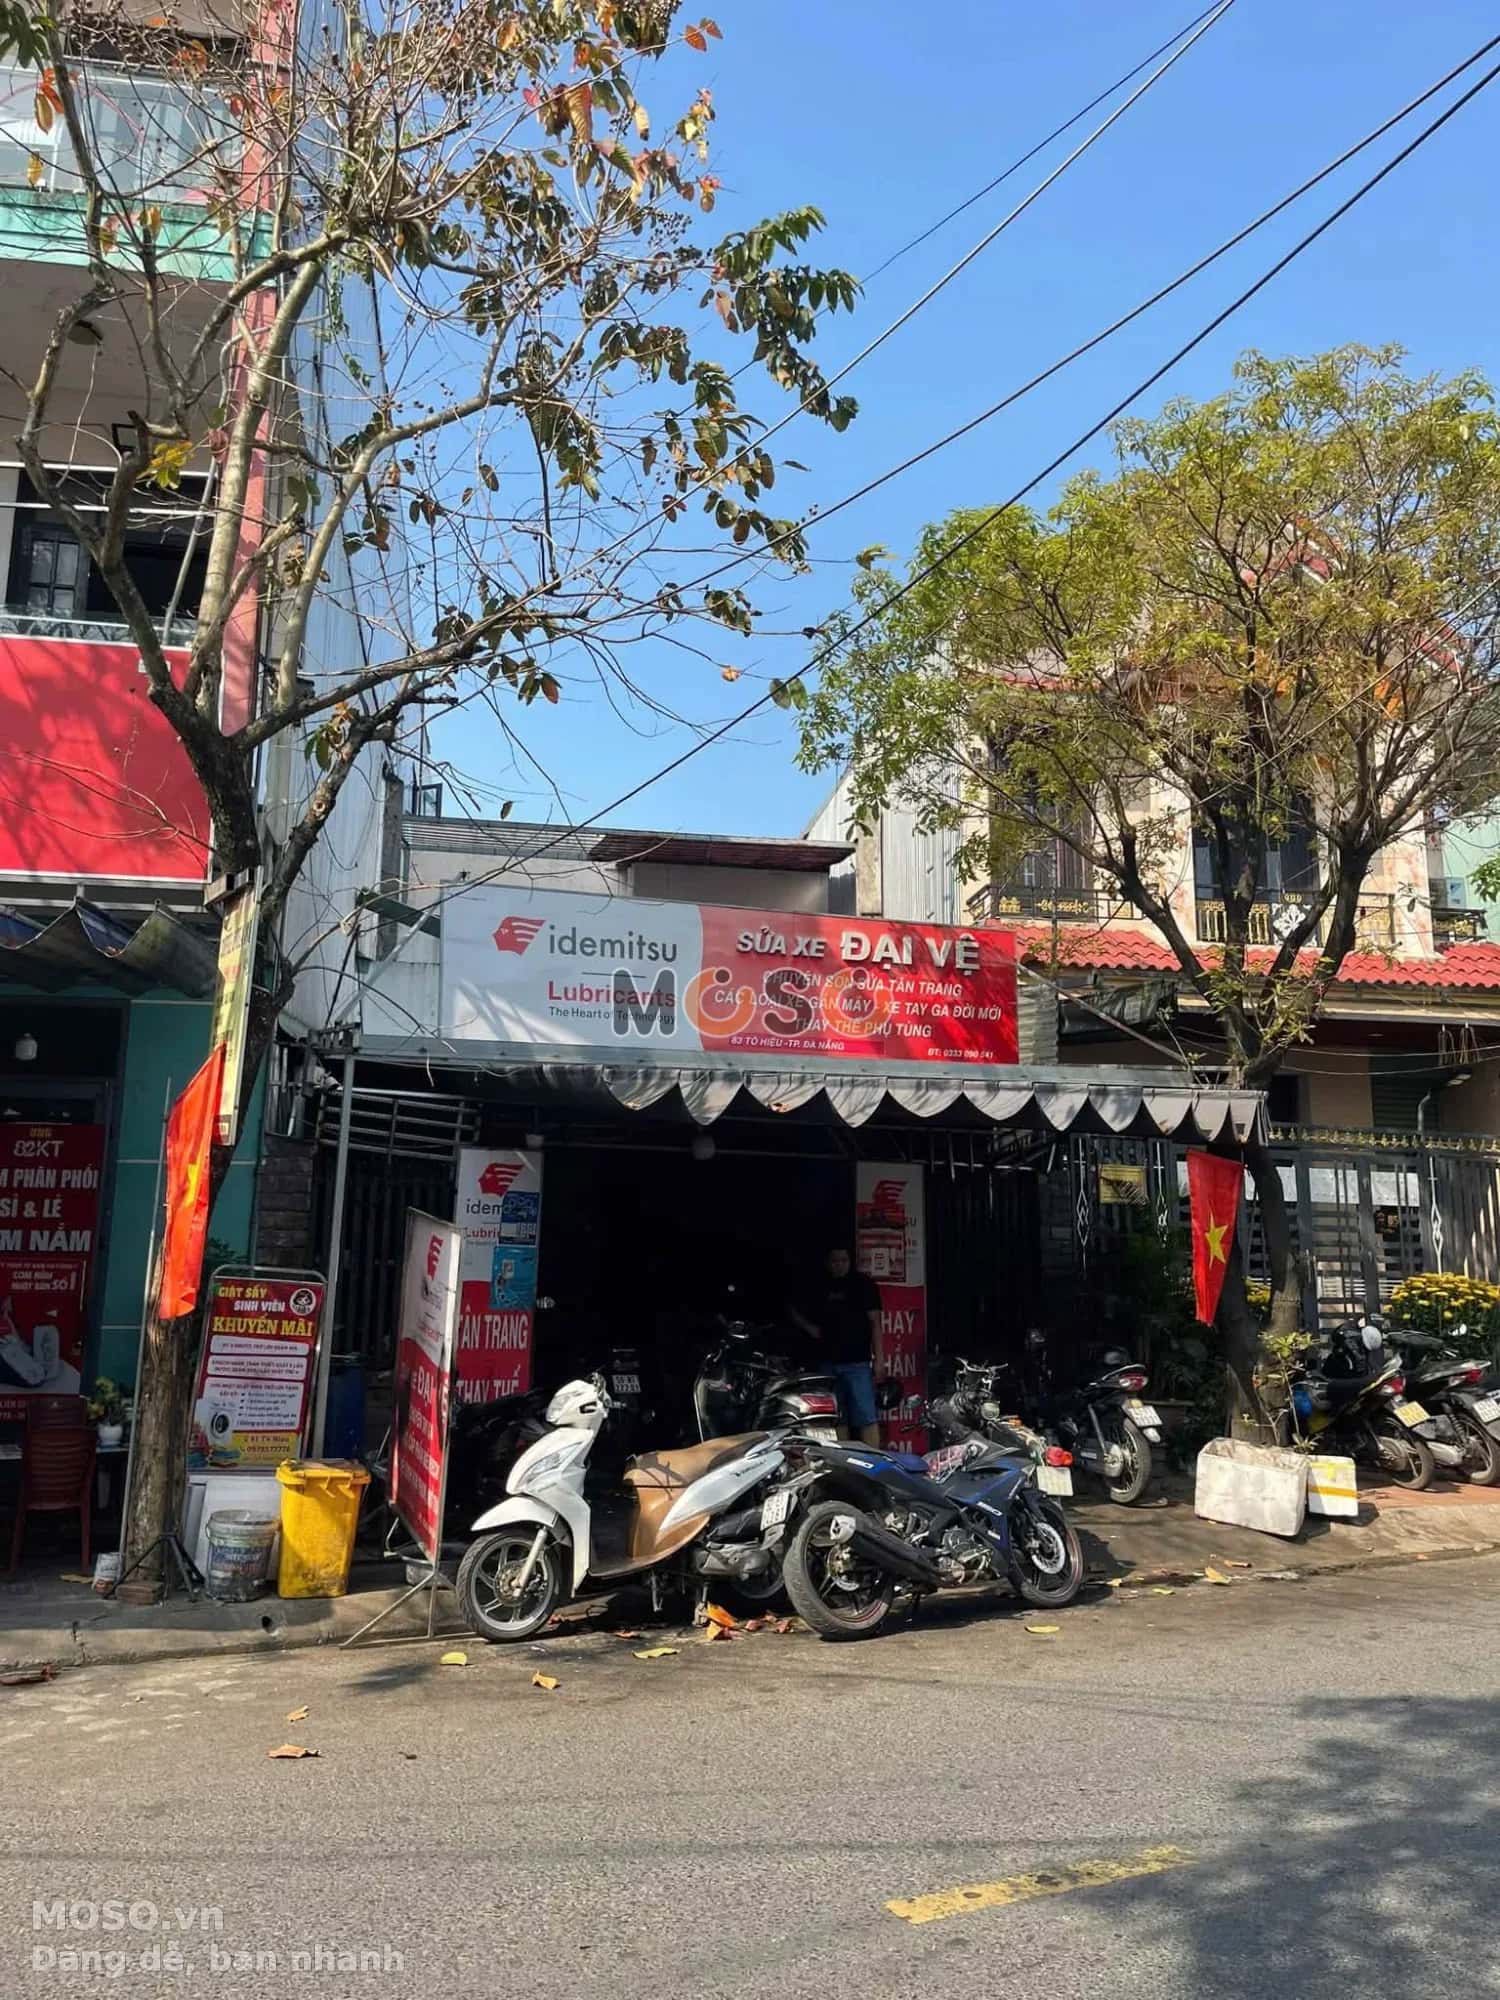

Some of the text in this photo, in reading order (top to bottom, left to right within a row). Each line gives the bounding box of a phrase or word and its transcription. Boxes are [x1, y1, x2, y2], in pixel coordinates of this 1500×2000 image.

[549, 924, 677, 962] idemitsu
[737, 925, 981, 977] SỬA XE ĐẠI VỆ
[889, 976, 915, 993] TÂN
[919, 981, 963, 997] TRANG
[549, 1006, 569, 1017] The
[571, 1008, 601, 1019] Heart
[842, 995, 872, 1013] MÁY
[882, 1001, 900, 1014] XE
[904, 1002, 928, 1016] TAY
[931, 1004, 949, 1017] GA
[953, 1002, 975, 1018] ĐỜI
[978, 1006, 1001, 1020] MỚI
[795, 1018, 829, 1033] THAY
[896, 1019, 932, 1037] TÙNG
[23, 1201, 38, 1218] &
[466, 1198, 502, 1215] idem
[466, 1227, 501, 1239] Lubri
[234, 1298, 285, 1312] SINH VIÊN
[212, 1313, 278, 1335] KHUYẾN
[484, 1312, 529, 1350] TRANG
[880, 1311, 916, 1340] HẠY
